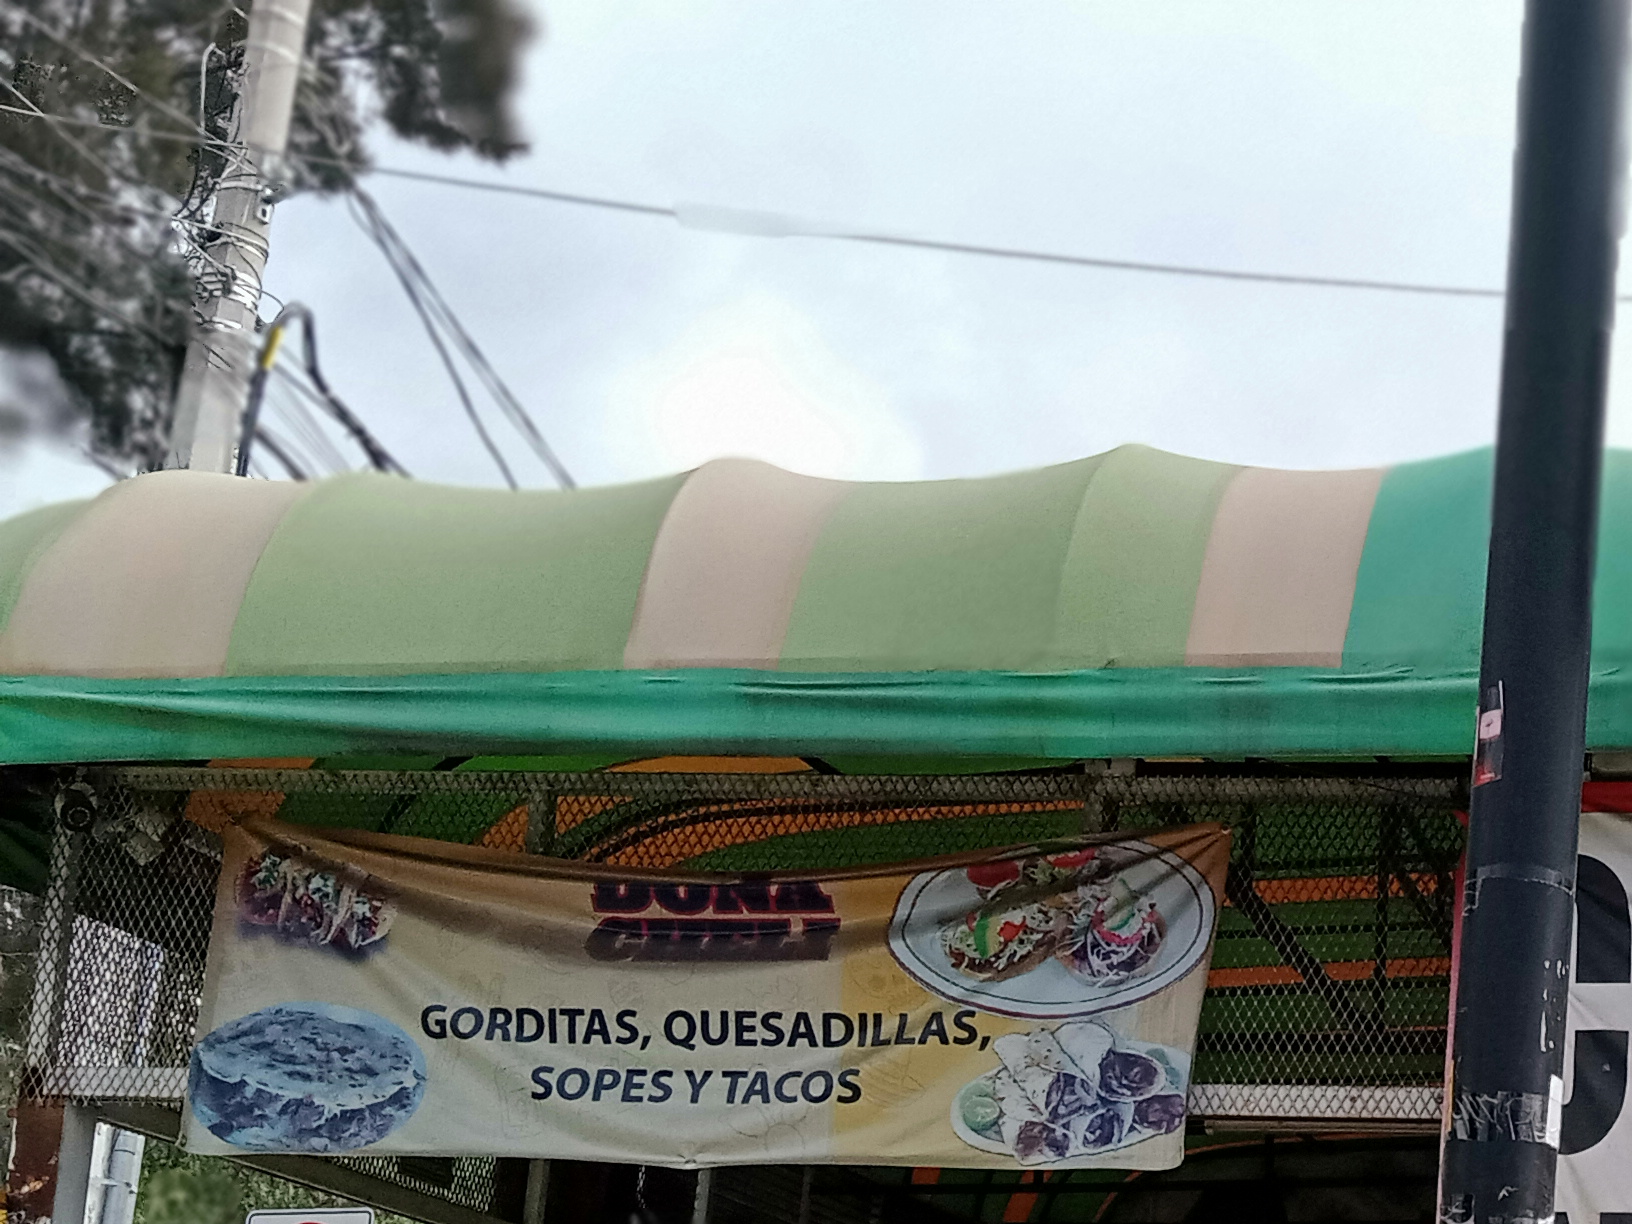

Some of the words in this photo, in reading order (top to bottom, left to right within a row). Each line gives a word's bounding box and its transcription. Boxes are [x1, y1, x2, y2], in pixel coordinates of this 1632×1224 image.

[420, 1004, 652, 1051] GORDITAS,
[663, 1009, 993, 1052] QUESADILLAS,
[530, 1065, 674, 1104] SOPES
[686, 1069, 711, 1104] Y
[720, 1068, 862, 1105] TACOS
